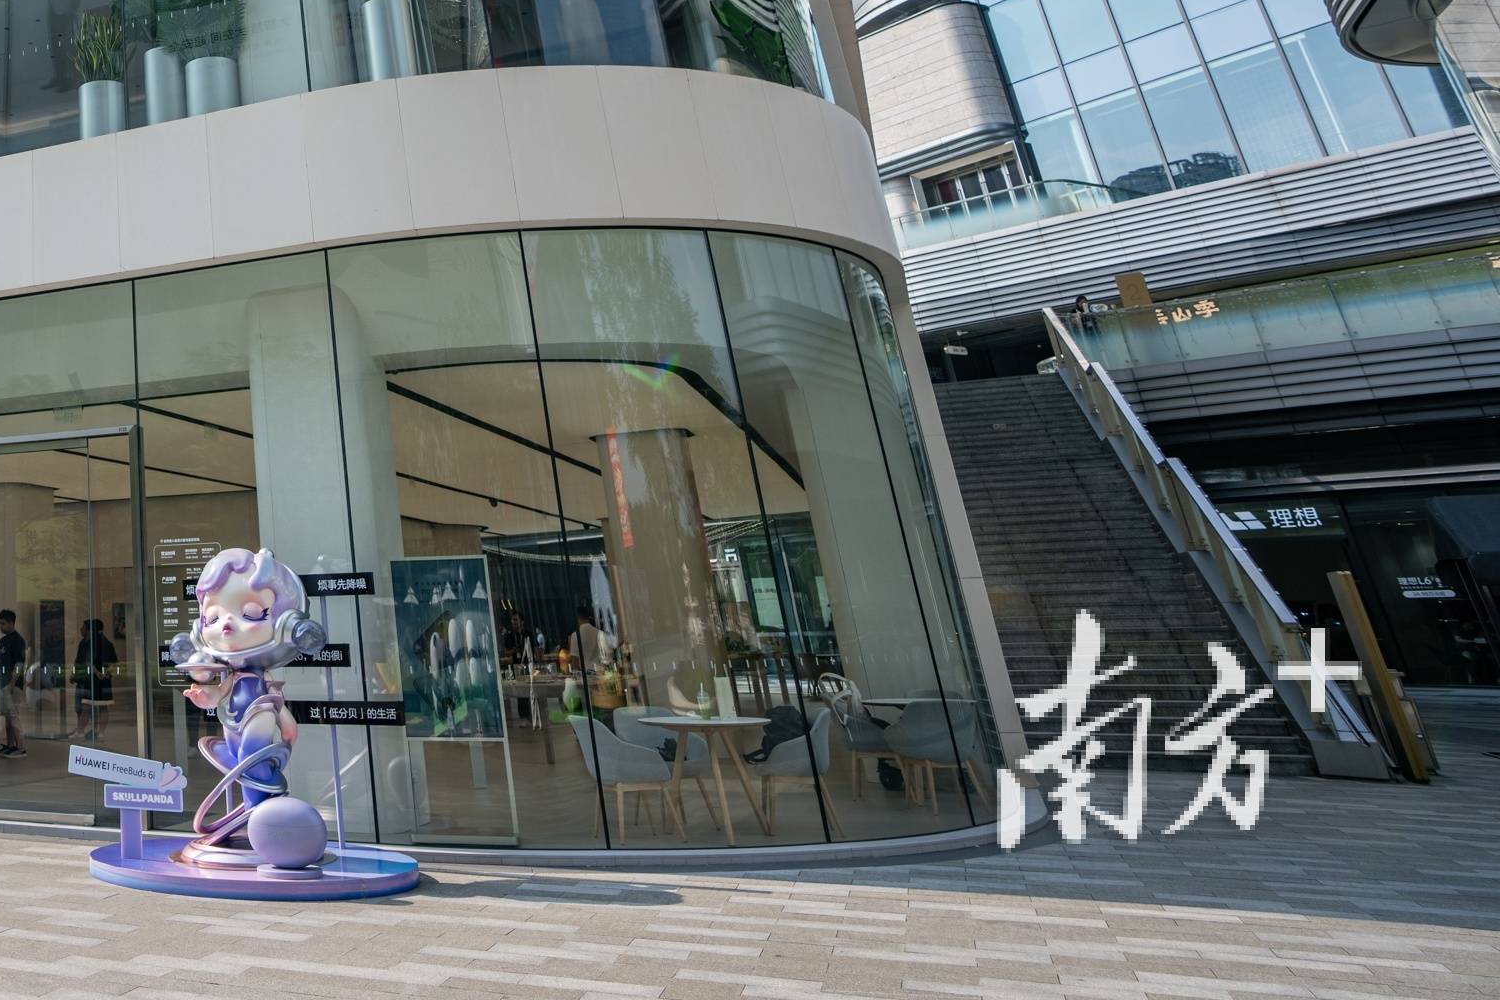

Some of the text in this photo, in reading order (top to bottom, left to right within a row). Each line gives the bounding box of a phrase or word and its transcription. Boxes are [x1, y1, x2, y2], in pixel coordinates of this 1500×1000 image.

[1267, 506, 1323, 529] 理想
[317, 578, 367, 591] 烦事先降噪
[310, 706, 397, 720] 过「低分贝」的生活
[75, 756, 156, 780] HUAWEI FreeBuds 6i
[112, 791, 174, 805] SKULLPANDA
